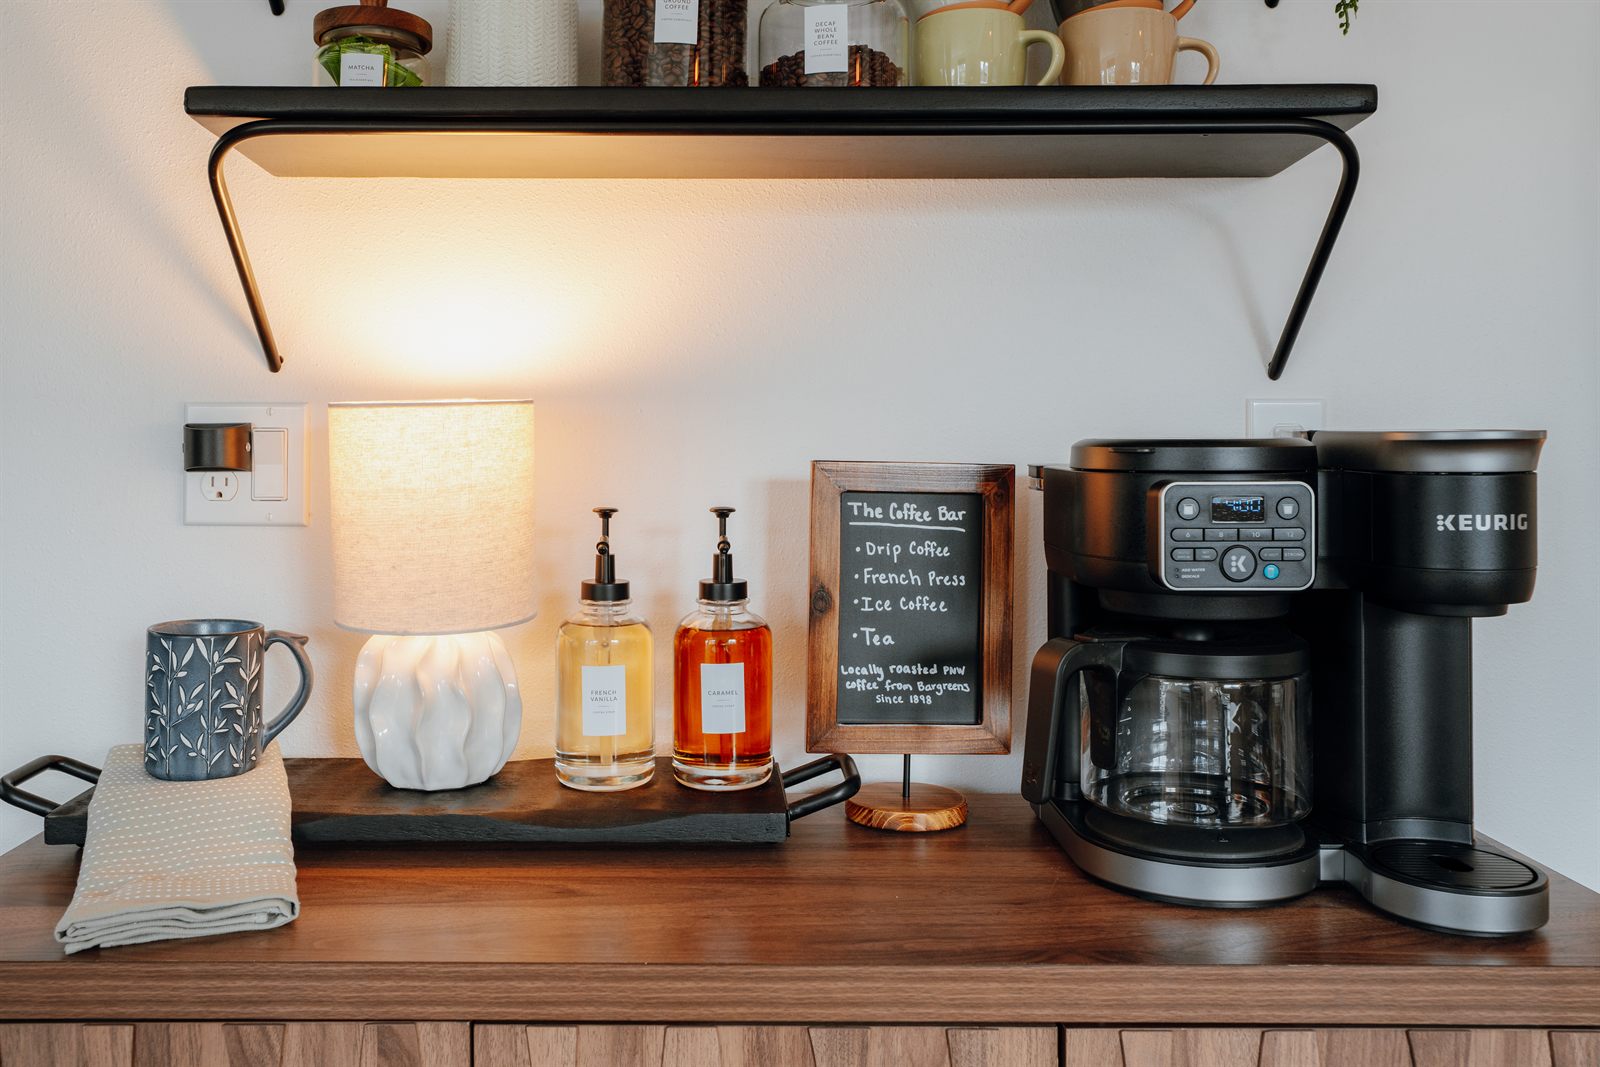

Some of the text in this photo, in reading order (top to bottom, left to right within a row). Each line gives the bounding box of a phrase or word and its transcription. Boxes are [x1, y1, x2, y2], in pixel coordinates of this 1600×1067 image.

[847, 502, 966, 522] The Coffee Bar
[1436, 513, 1528, 531] KEURIG
[866, 541, 950, 563] Drip Coffee
[863, 567, 966, 586] French Press
[860, 596, 948, 612] Ice Coffee
[860, 627, 896, 646] Tea
[841, 663, 966, 681] Locally roasted PNW
[845, 679, 971, 696] coffee from Bargreens
[909, 694, 933, 705] 1898
